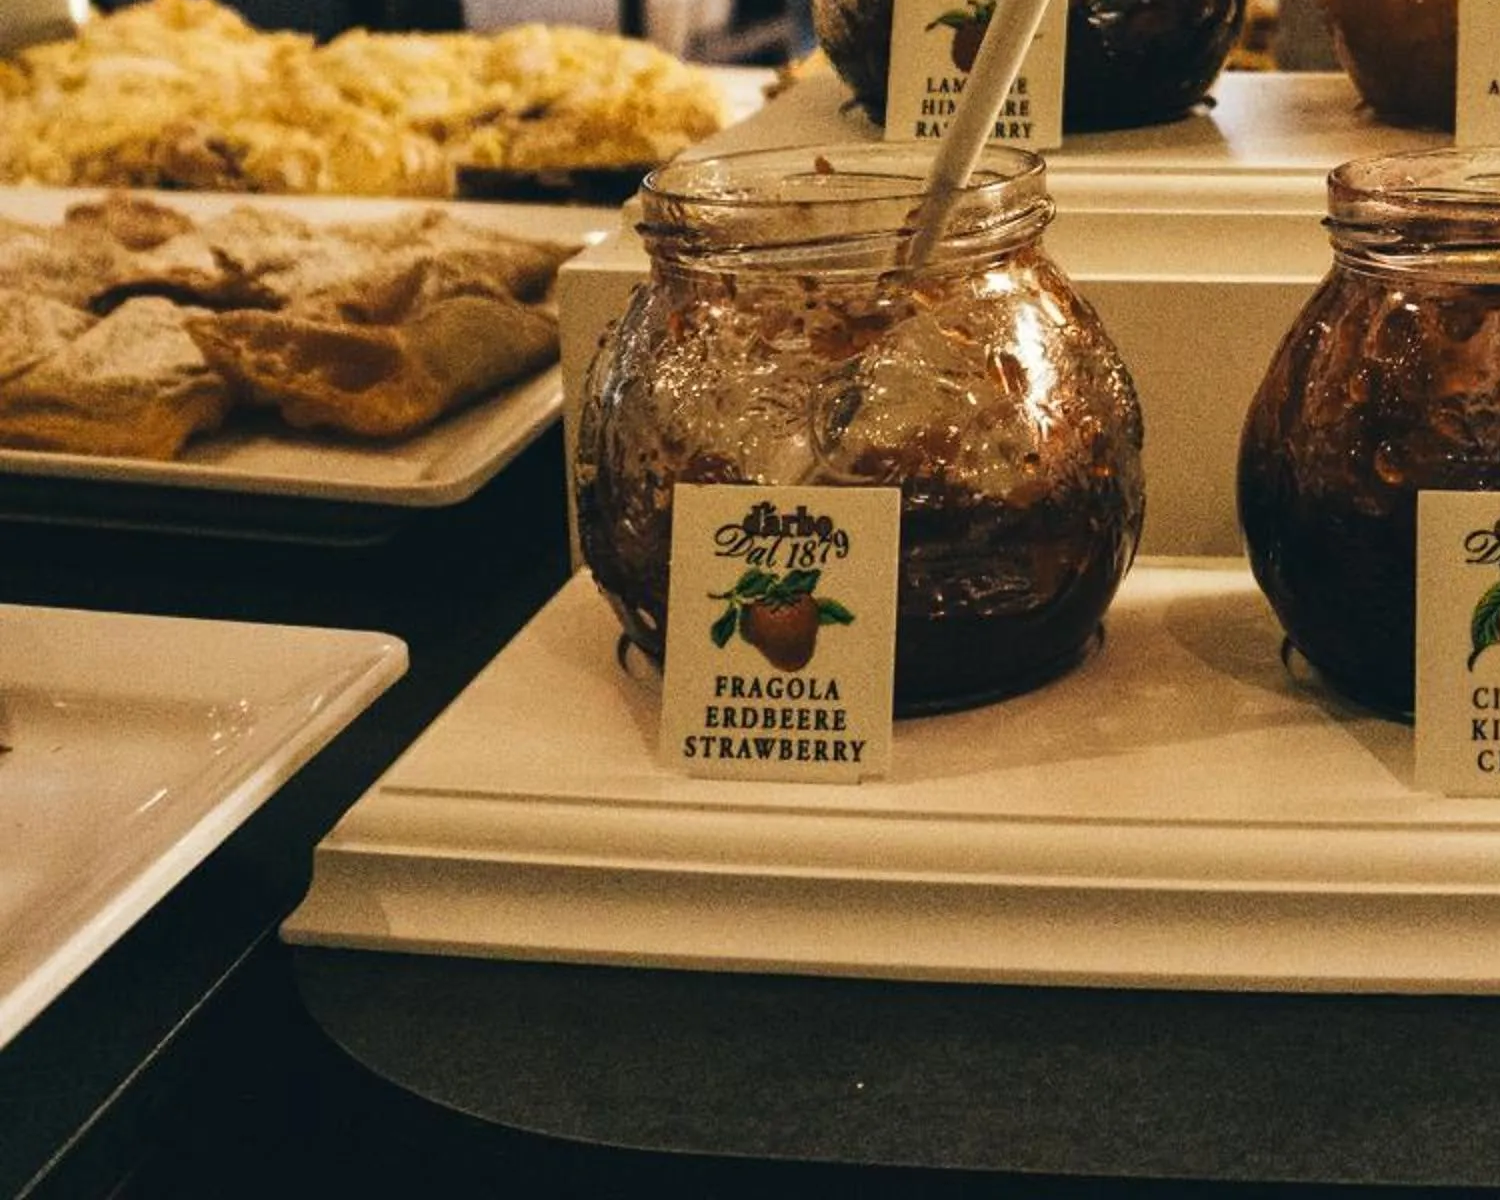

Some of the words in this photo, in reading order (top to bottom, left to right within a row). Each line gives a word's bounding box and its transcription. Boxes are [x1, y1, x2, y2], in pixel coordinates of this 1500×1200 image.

[927, 77, 1028, 94] LAME
[921, 99, 1030, 116] HIMRE
[915, 121, 1033, 138] RARRY
[714, 523, 782, 568] Dal
[786, 528, 850, 569] 1879
[715, 676, 840, 700] FRAGOLA
[704, 706, 847, 731] ERDBEERE
[683, 735, 867, 763] STRAWBERRY
